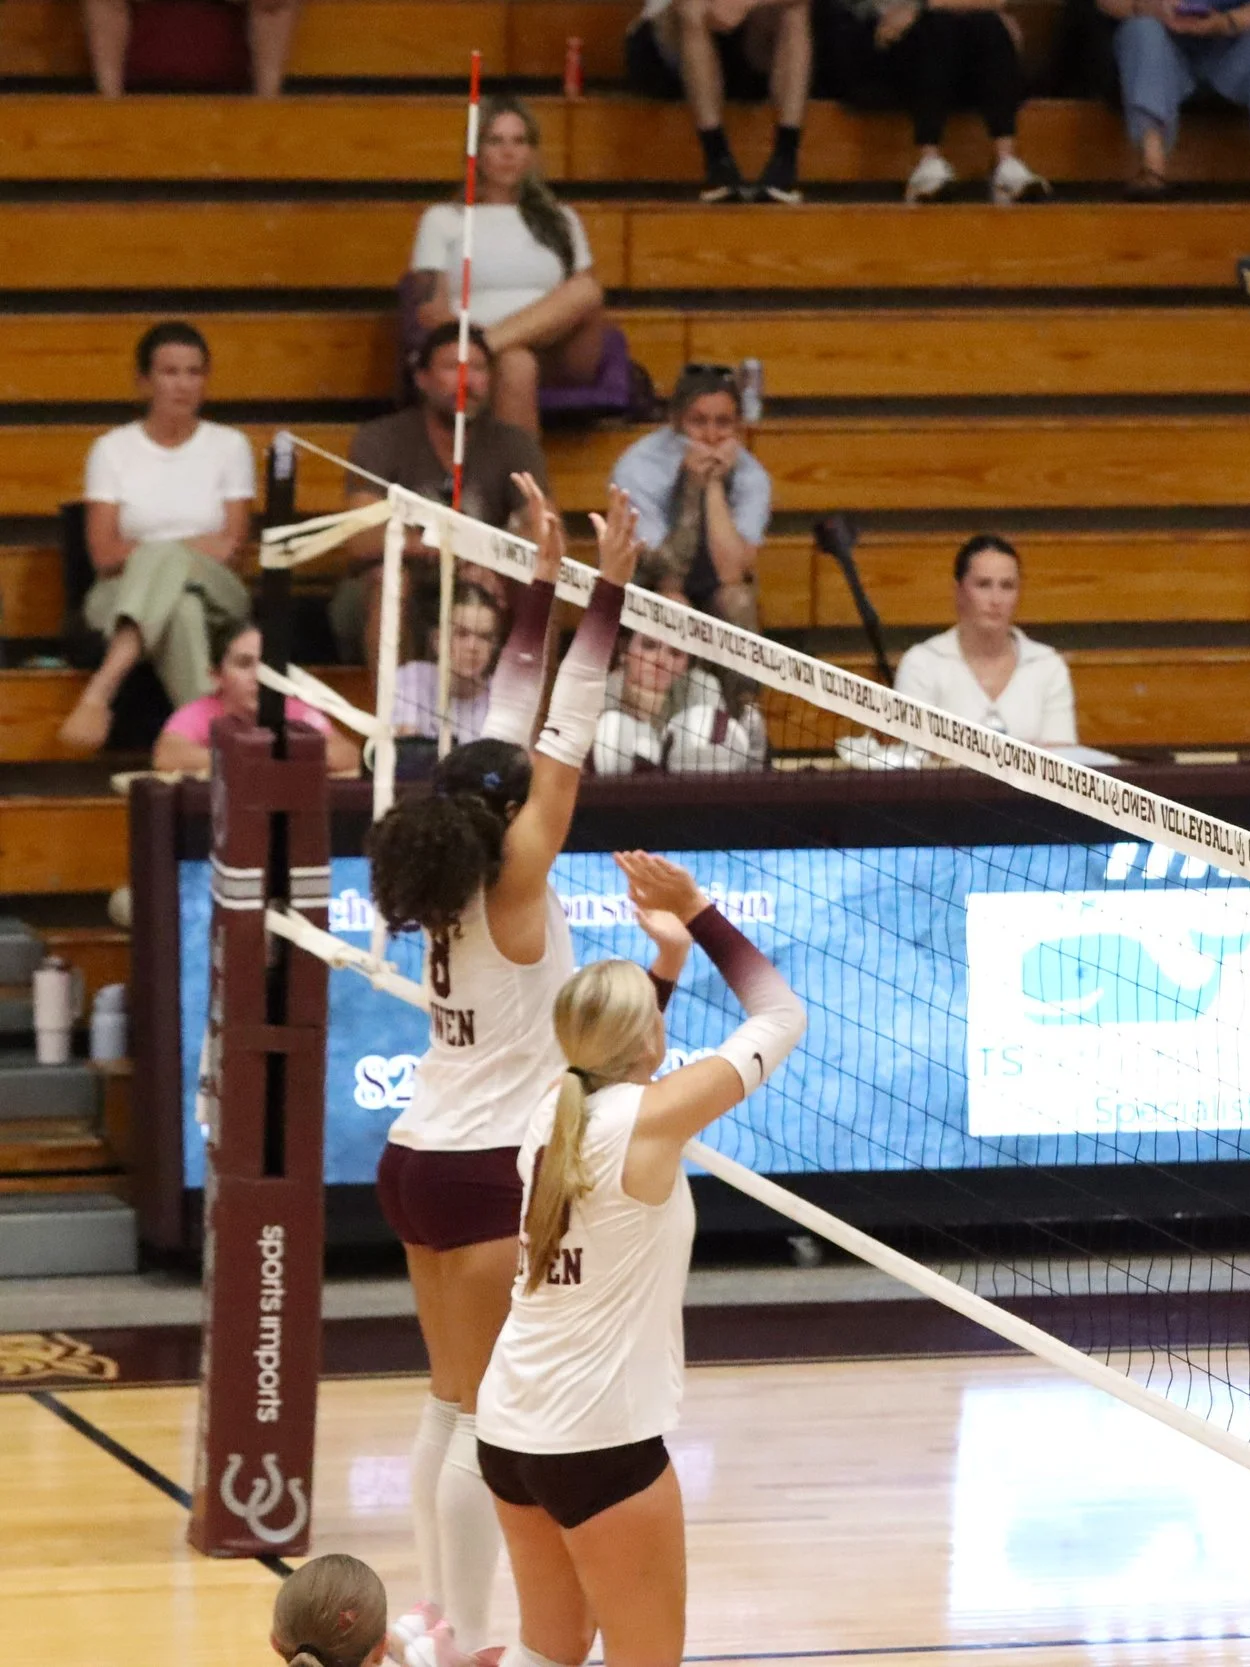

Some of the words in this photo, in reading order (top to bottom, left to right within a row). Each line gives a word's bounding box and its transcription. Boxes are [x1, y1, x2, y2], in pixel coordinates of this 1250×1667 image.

[893, 698, 921, 729] OWEN
[927, 711, 990, 758] VOLLEYBALL
[1004, 743, 1036, 777] OWEN
[1040, 756, 1109, 806] VOLLEYBALL
[1122, 788, 1155, 824] OWEN
[1160, 803, 1233, 855] VOLLEYBALL
[431, 1002, 475, 1048] WEN
[256, 1224, 287, 1312] sports
[548, 1247, 584, 1286] EN
[252, 1316, 283, 1423] imports
